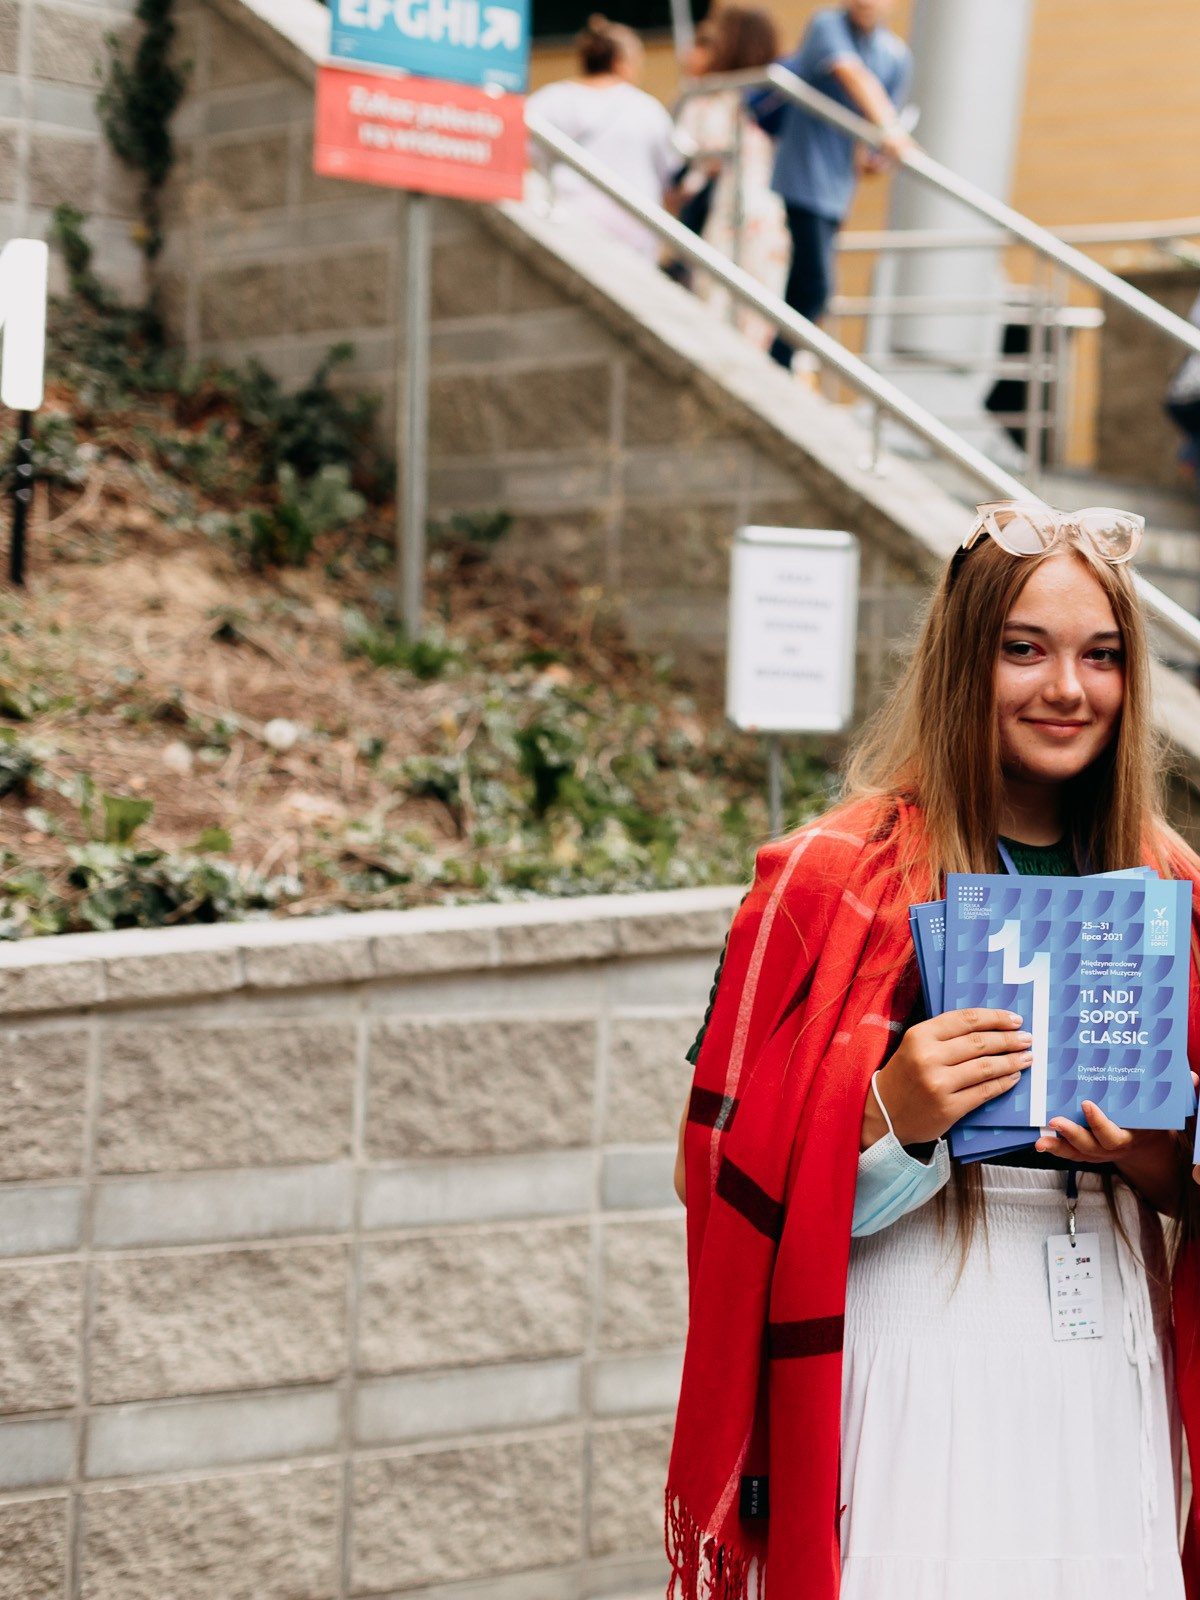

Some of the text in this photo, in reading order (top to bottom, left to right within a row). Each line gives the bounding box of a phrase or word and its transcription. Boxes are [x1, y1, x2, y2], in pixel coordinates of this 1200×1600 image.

[1081, 932, 1123, 942] lipca 2021
[1081, 959, 1137, 969] Międzynarodowy
[1080, 968, 1142, 978] Festiwal Muzyczny
[1080, 989, 1134, 1004] 11. NDI
[1079, 1009, 1139, 1025] SOPOT
[1079, 1029, 1149, 1045] CLASSIC
[1078, 1065, 1146, 1075] Dyrektor Artystyczny
[1077, 1074, 1107, 1083] Wojciech
